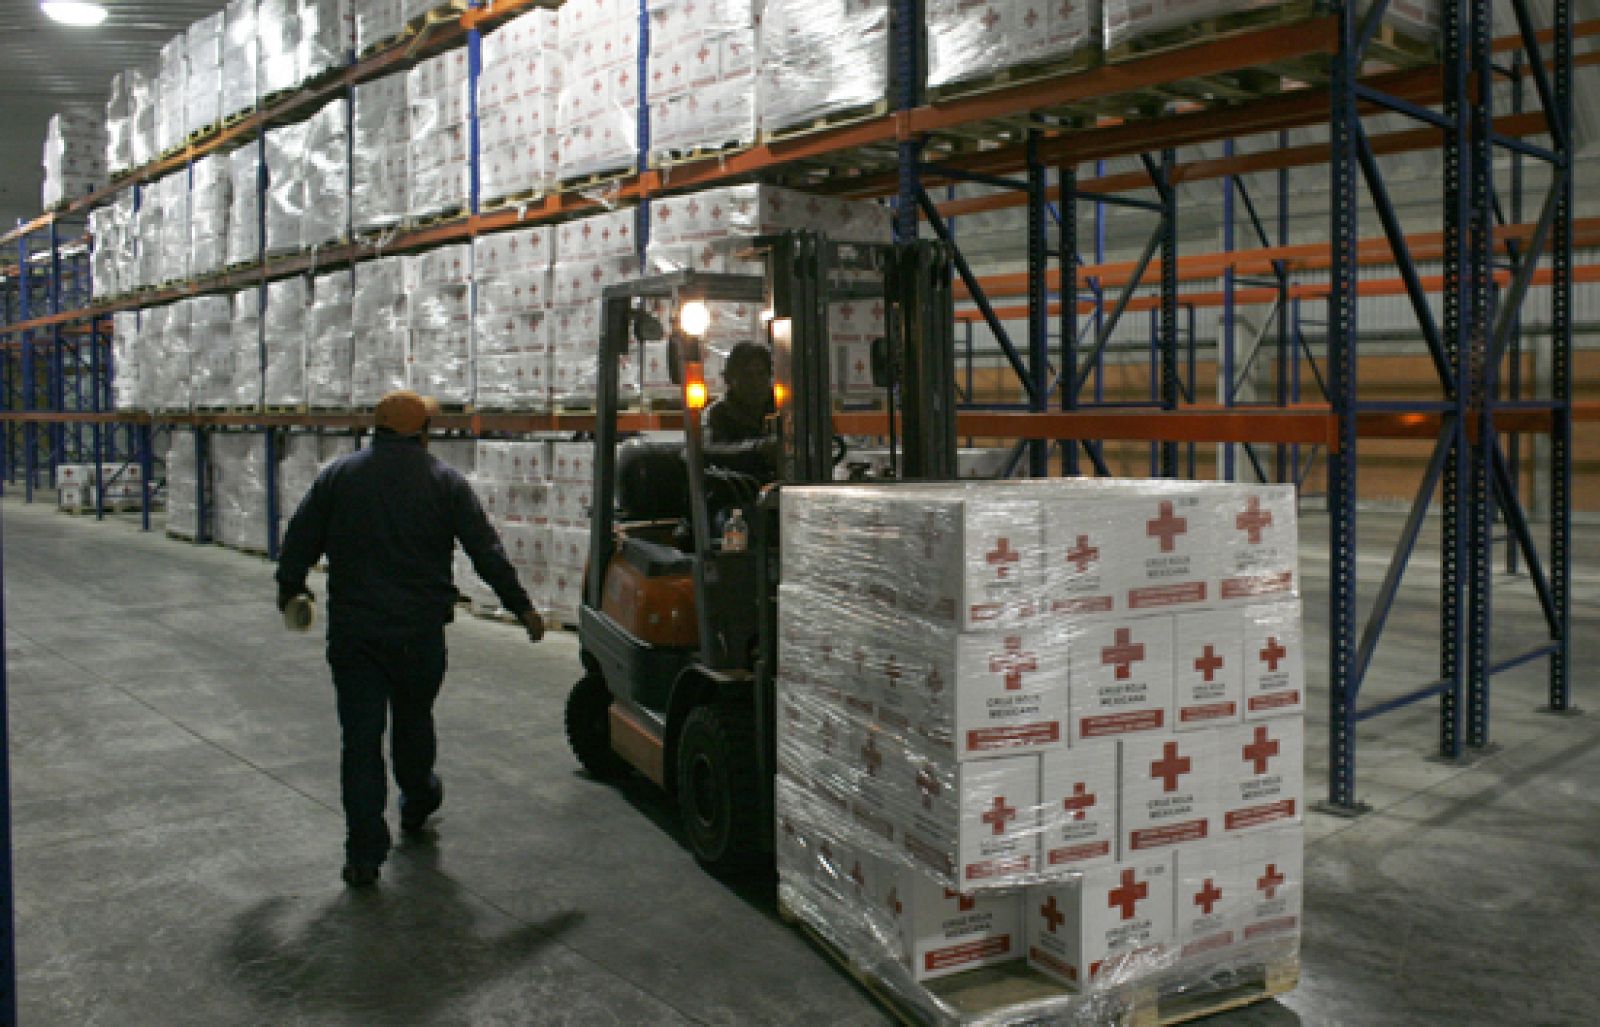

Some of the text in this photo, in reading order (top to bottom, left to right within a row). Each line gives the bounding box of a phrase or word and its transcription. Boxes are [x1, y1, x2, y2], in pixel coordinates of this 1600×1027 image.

[1098, 683, 1147, 695] CRUZ ROJA
[1099, 695, 1147, 705] MEXICANA
